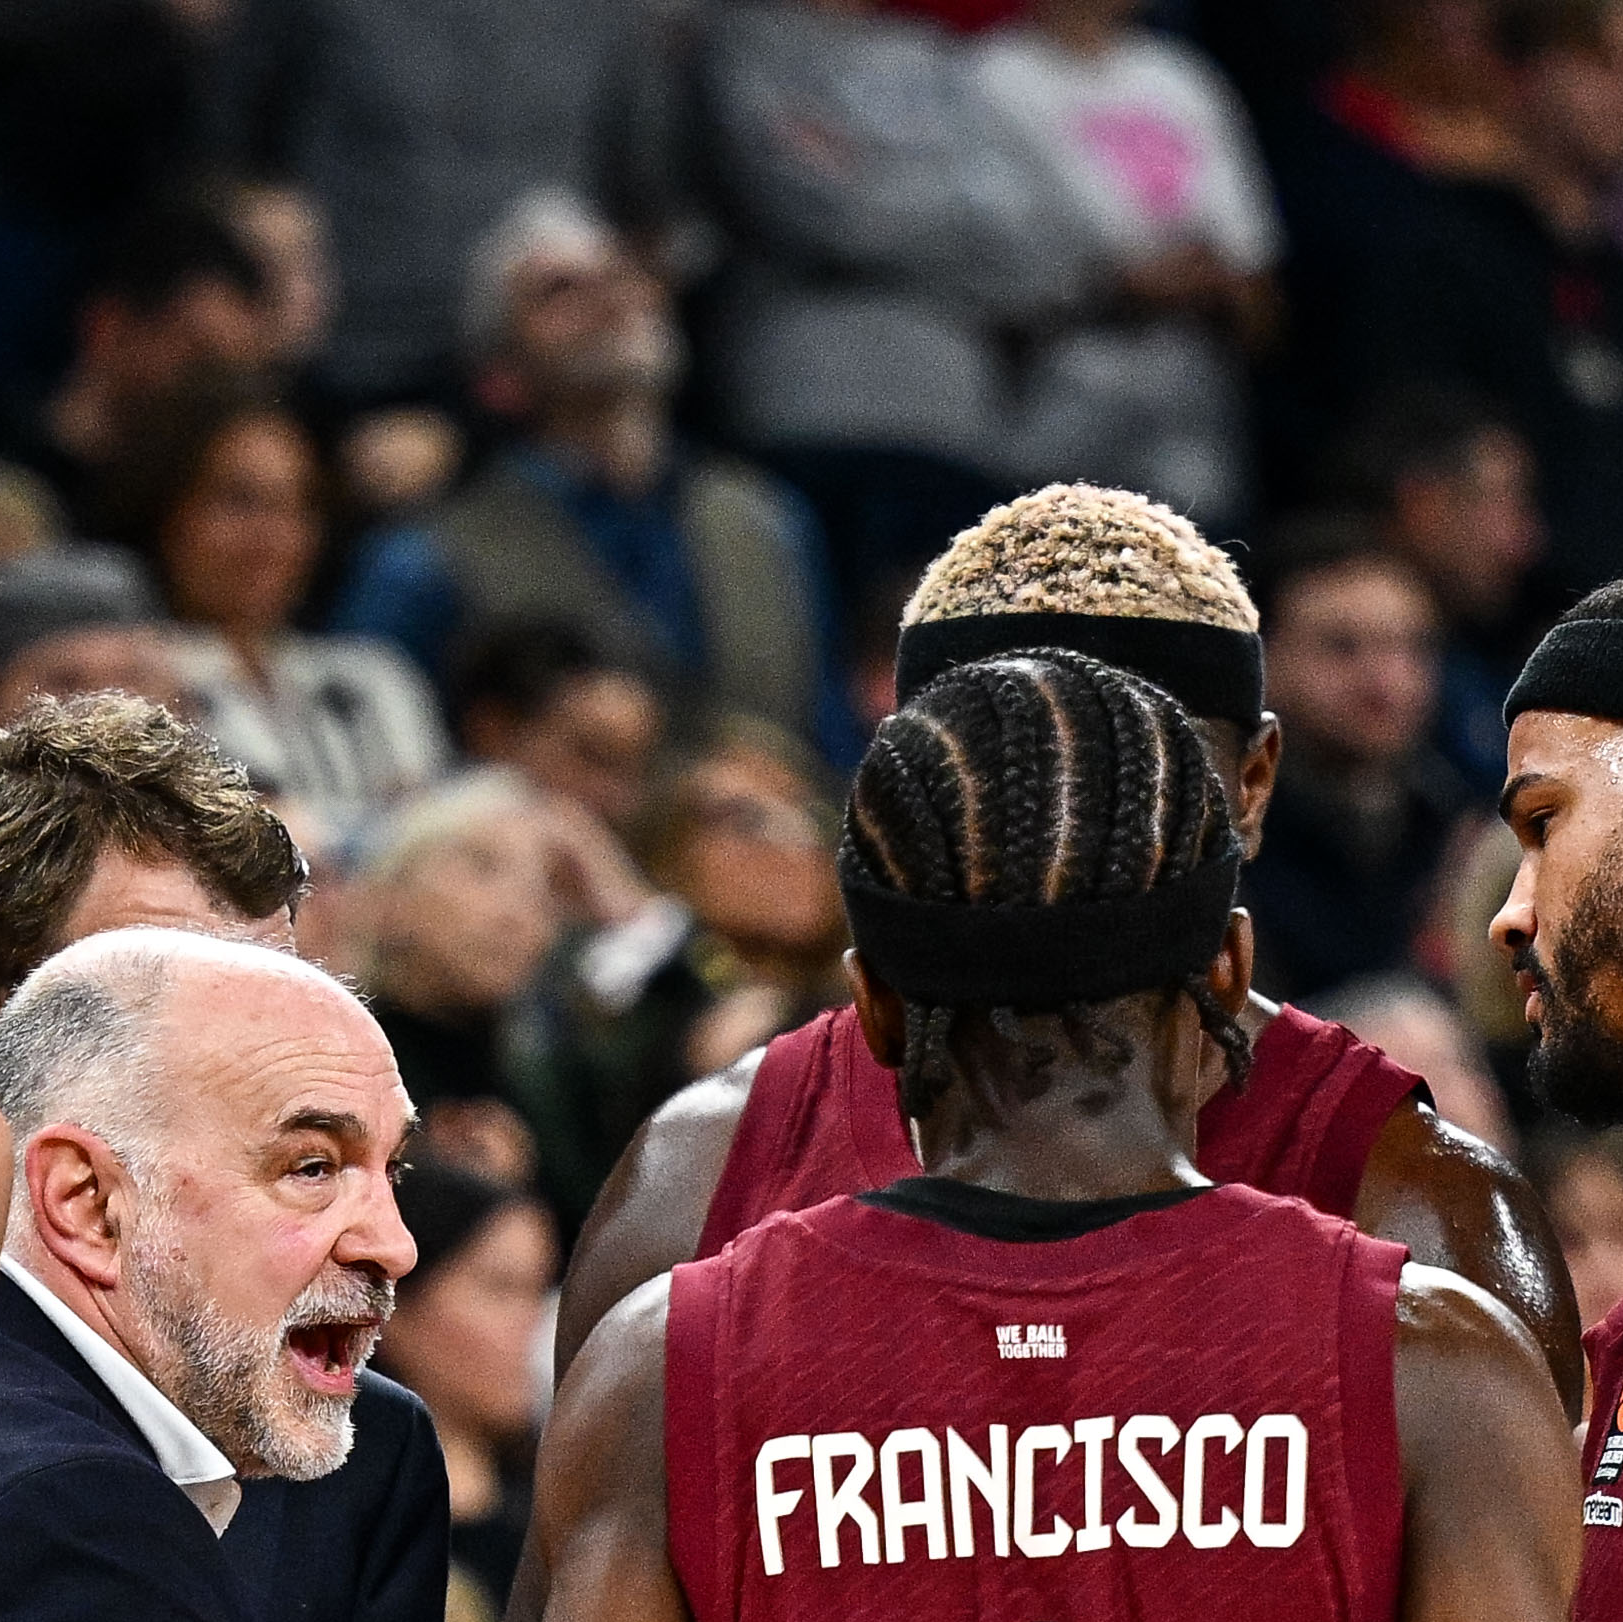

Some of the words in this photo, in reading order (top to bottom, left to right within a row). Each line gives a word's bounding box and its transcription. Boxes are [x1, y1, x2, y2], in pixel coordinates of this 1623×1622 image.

[995, 1325, 1021, 1344] WE
[1026, 1325, 1066, 1344] BALL
[997, 1343, 1068, 1360] TOGETHER
[754, 1413, 1310, 1577] FRANCISCO
